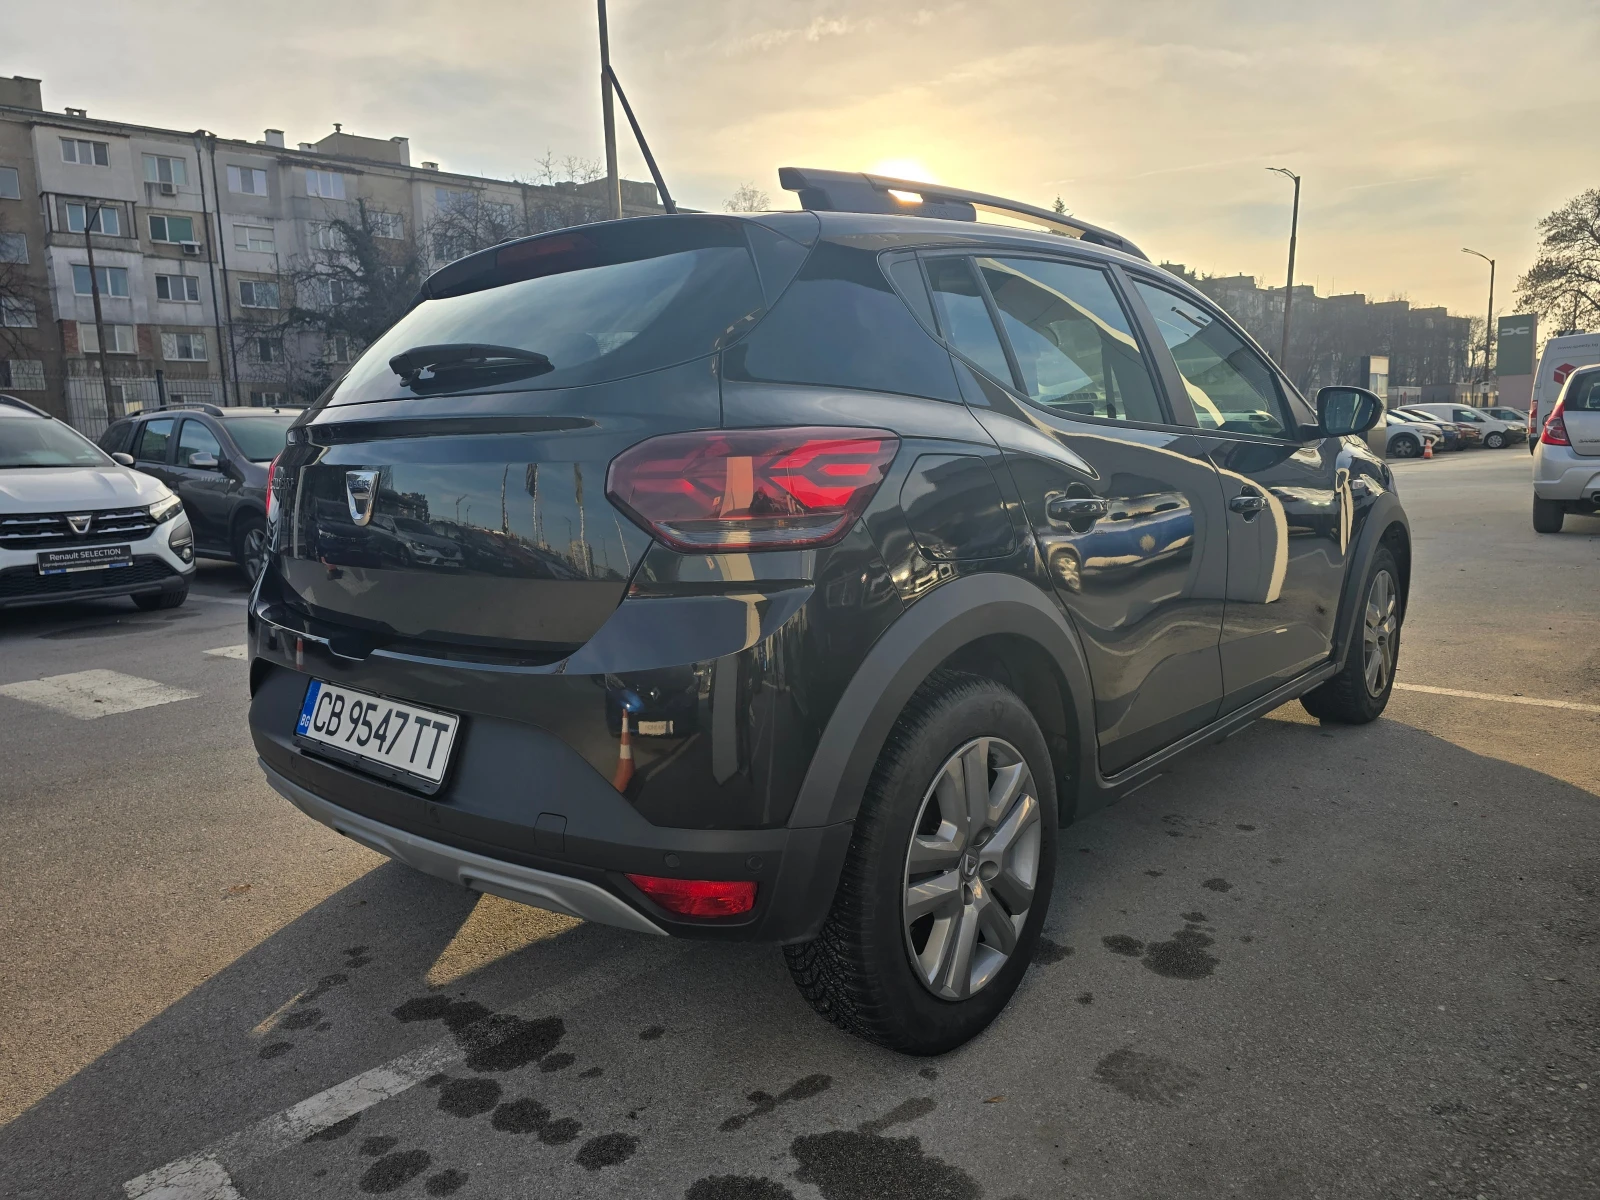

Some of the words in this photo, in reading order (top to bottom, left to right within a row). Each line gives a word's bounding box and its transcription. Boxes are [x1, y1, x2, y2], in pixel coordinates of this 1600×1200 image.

[49, 552, 79, 561] Renault
[80, 548, 121, 558] SELECTION
[300, 713, 310, 727] BG
[313, 691, 345, 736] CB
[345, 700, 410, 755] 9547
[409, 716, 450, 770] TT
